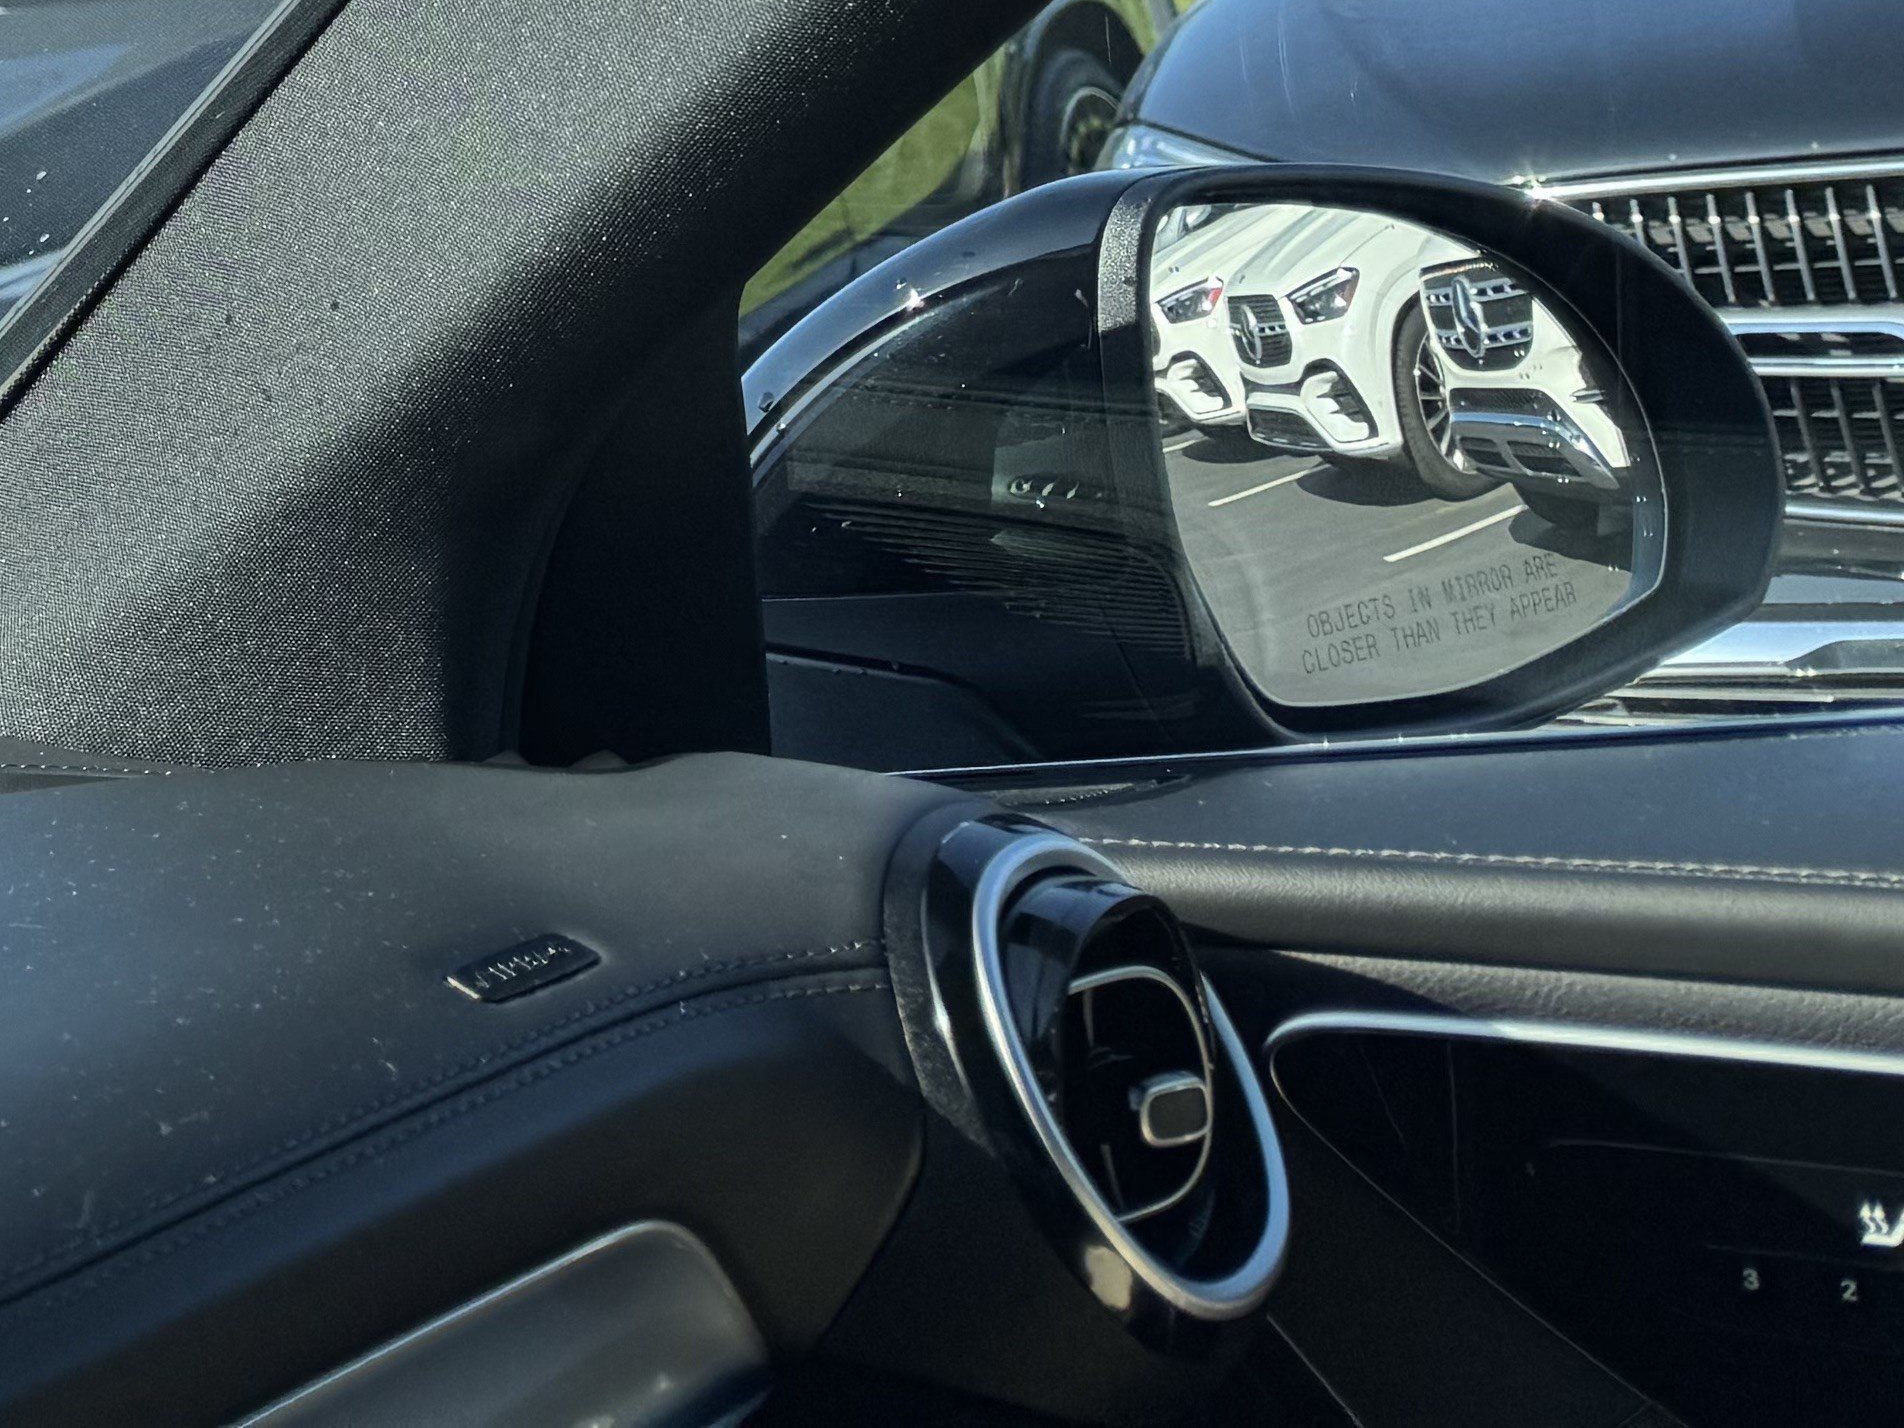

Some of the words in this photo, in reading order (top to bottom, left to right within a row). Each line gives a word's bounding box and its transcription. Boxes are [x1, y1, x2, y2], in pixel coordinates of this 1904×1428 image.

[1302, 633, 1382, 675] CLOSER
[1390, 616, 1442, 653] THAN
[1450, 606, 1497, 636] THEY
[1509, 581, 1578, 621] APPEAR
[1306, 594, 1396, 638] OBJECTS
[1408, 586, 1433, 614] IN
[1441, 564, 1514, 604] MIRROR
[1522, 552, 1559, 584] ARE
[1742, 1267, 1760, 1291] 3
[1840, 1279, 1859, 1302] 2
